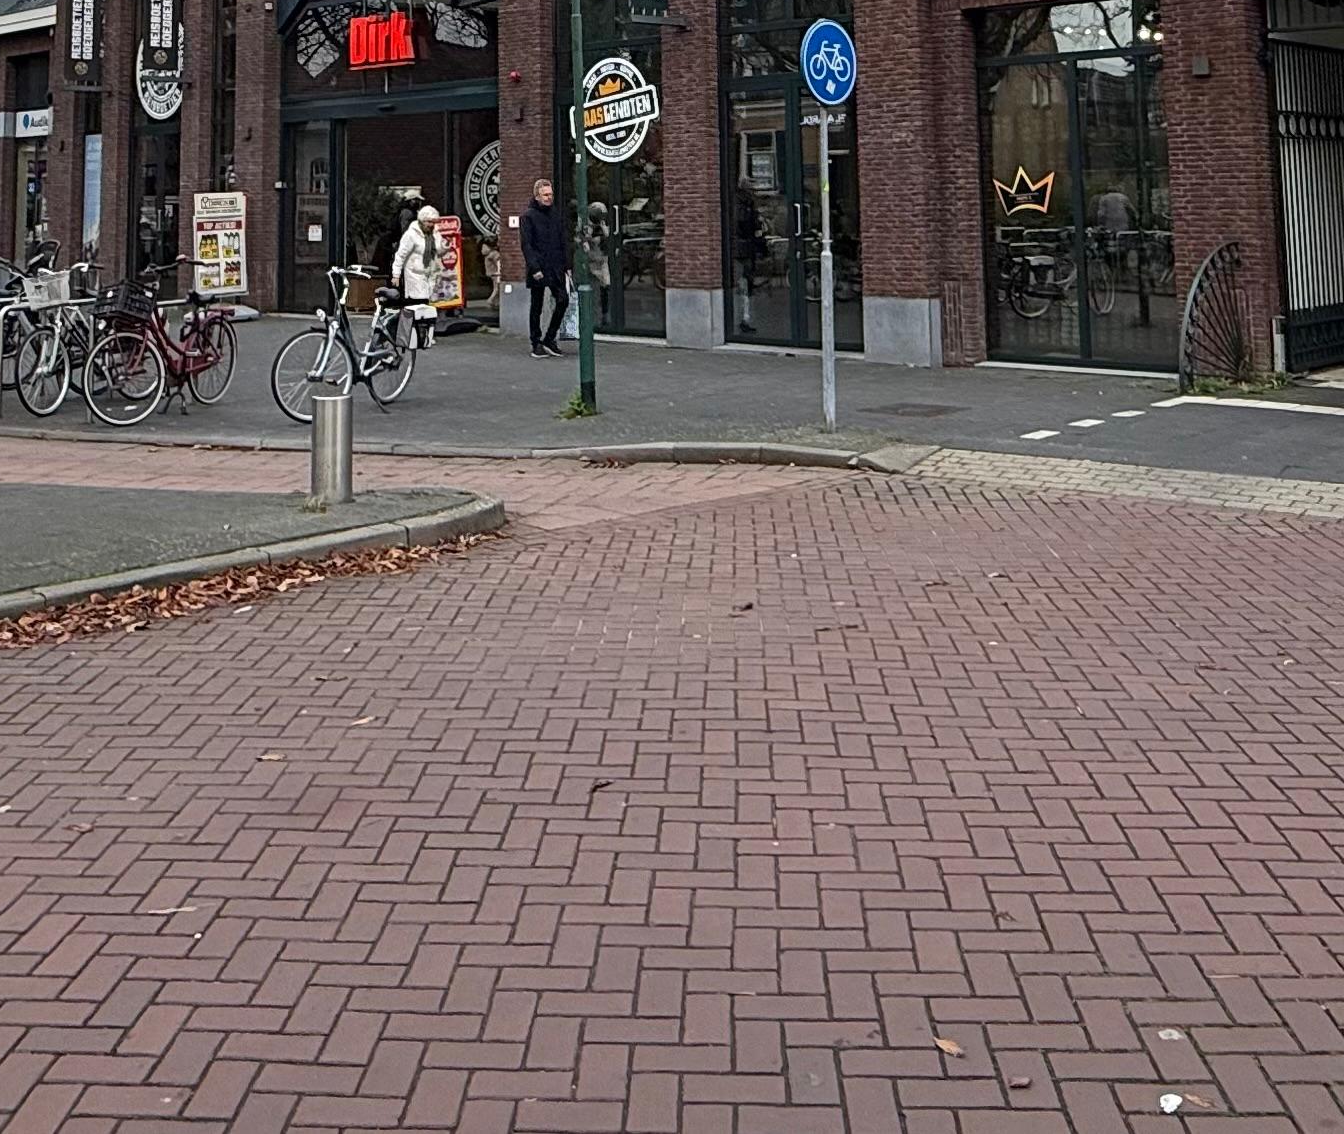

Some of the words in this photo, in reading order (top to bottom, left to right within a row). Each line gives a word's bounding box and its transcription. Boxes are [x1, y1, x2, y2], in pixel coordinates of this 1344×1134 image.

[350, 11, 415, 65] Dirk
[583, 93, 652, 128] AASGENOTEN
[469, 145, 501, 200] GOEDGER
